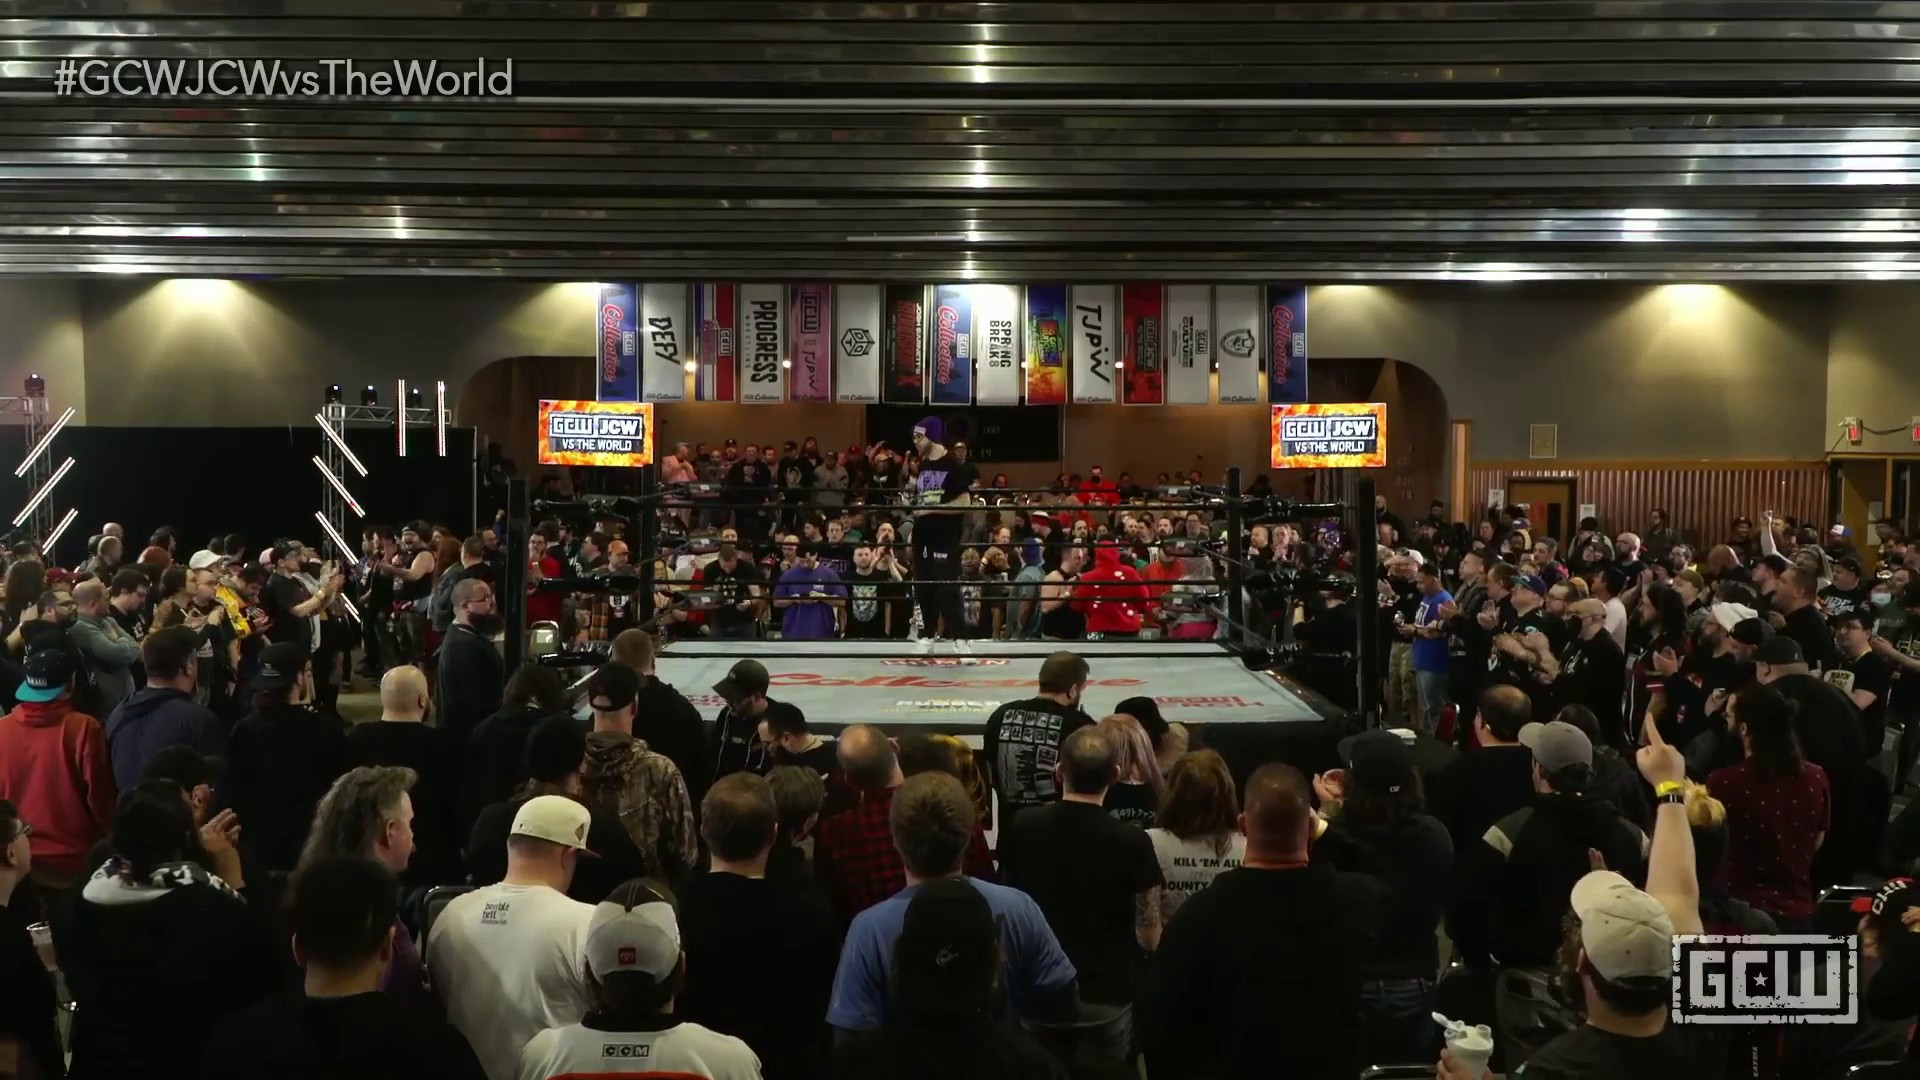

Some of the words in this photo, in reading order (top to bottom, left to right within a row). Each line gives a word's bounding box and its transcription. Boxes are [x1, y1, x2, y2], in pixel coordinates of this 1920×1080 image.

[803, 295, 818, 331] GCW
[648, 316, 681, 365] DEFY
[750, 300, 778, 383] PROGRESS
[938, 306, 959, 384] Collective
[553, 417, 593, 434] GCW
[599, 419, 639, 436] JCW
[1286, 421, 1326, 437] GCW
[1332, 420, 1372, 437] JCW
[562, 439, 575, 450] VS
[577, 439, 596, 450] THE
[598, 439, 632, 451] WORLD
[1295, 441, 1308, 453] VS
[1310, 441, 1328, 453] THE
[1330, 441, 1365, 452] WORLD
[1174, 857, 1197, 867] KILL
[1200, 858, 1219, 867] 'EM
[602, 1044, 649, 1057] CCM
